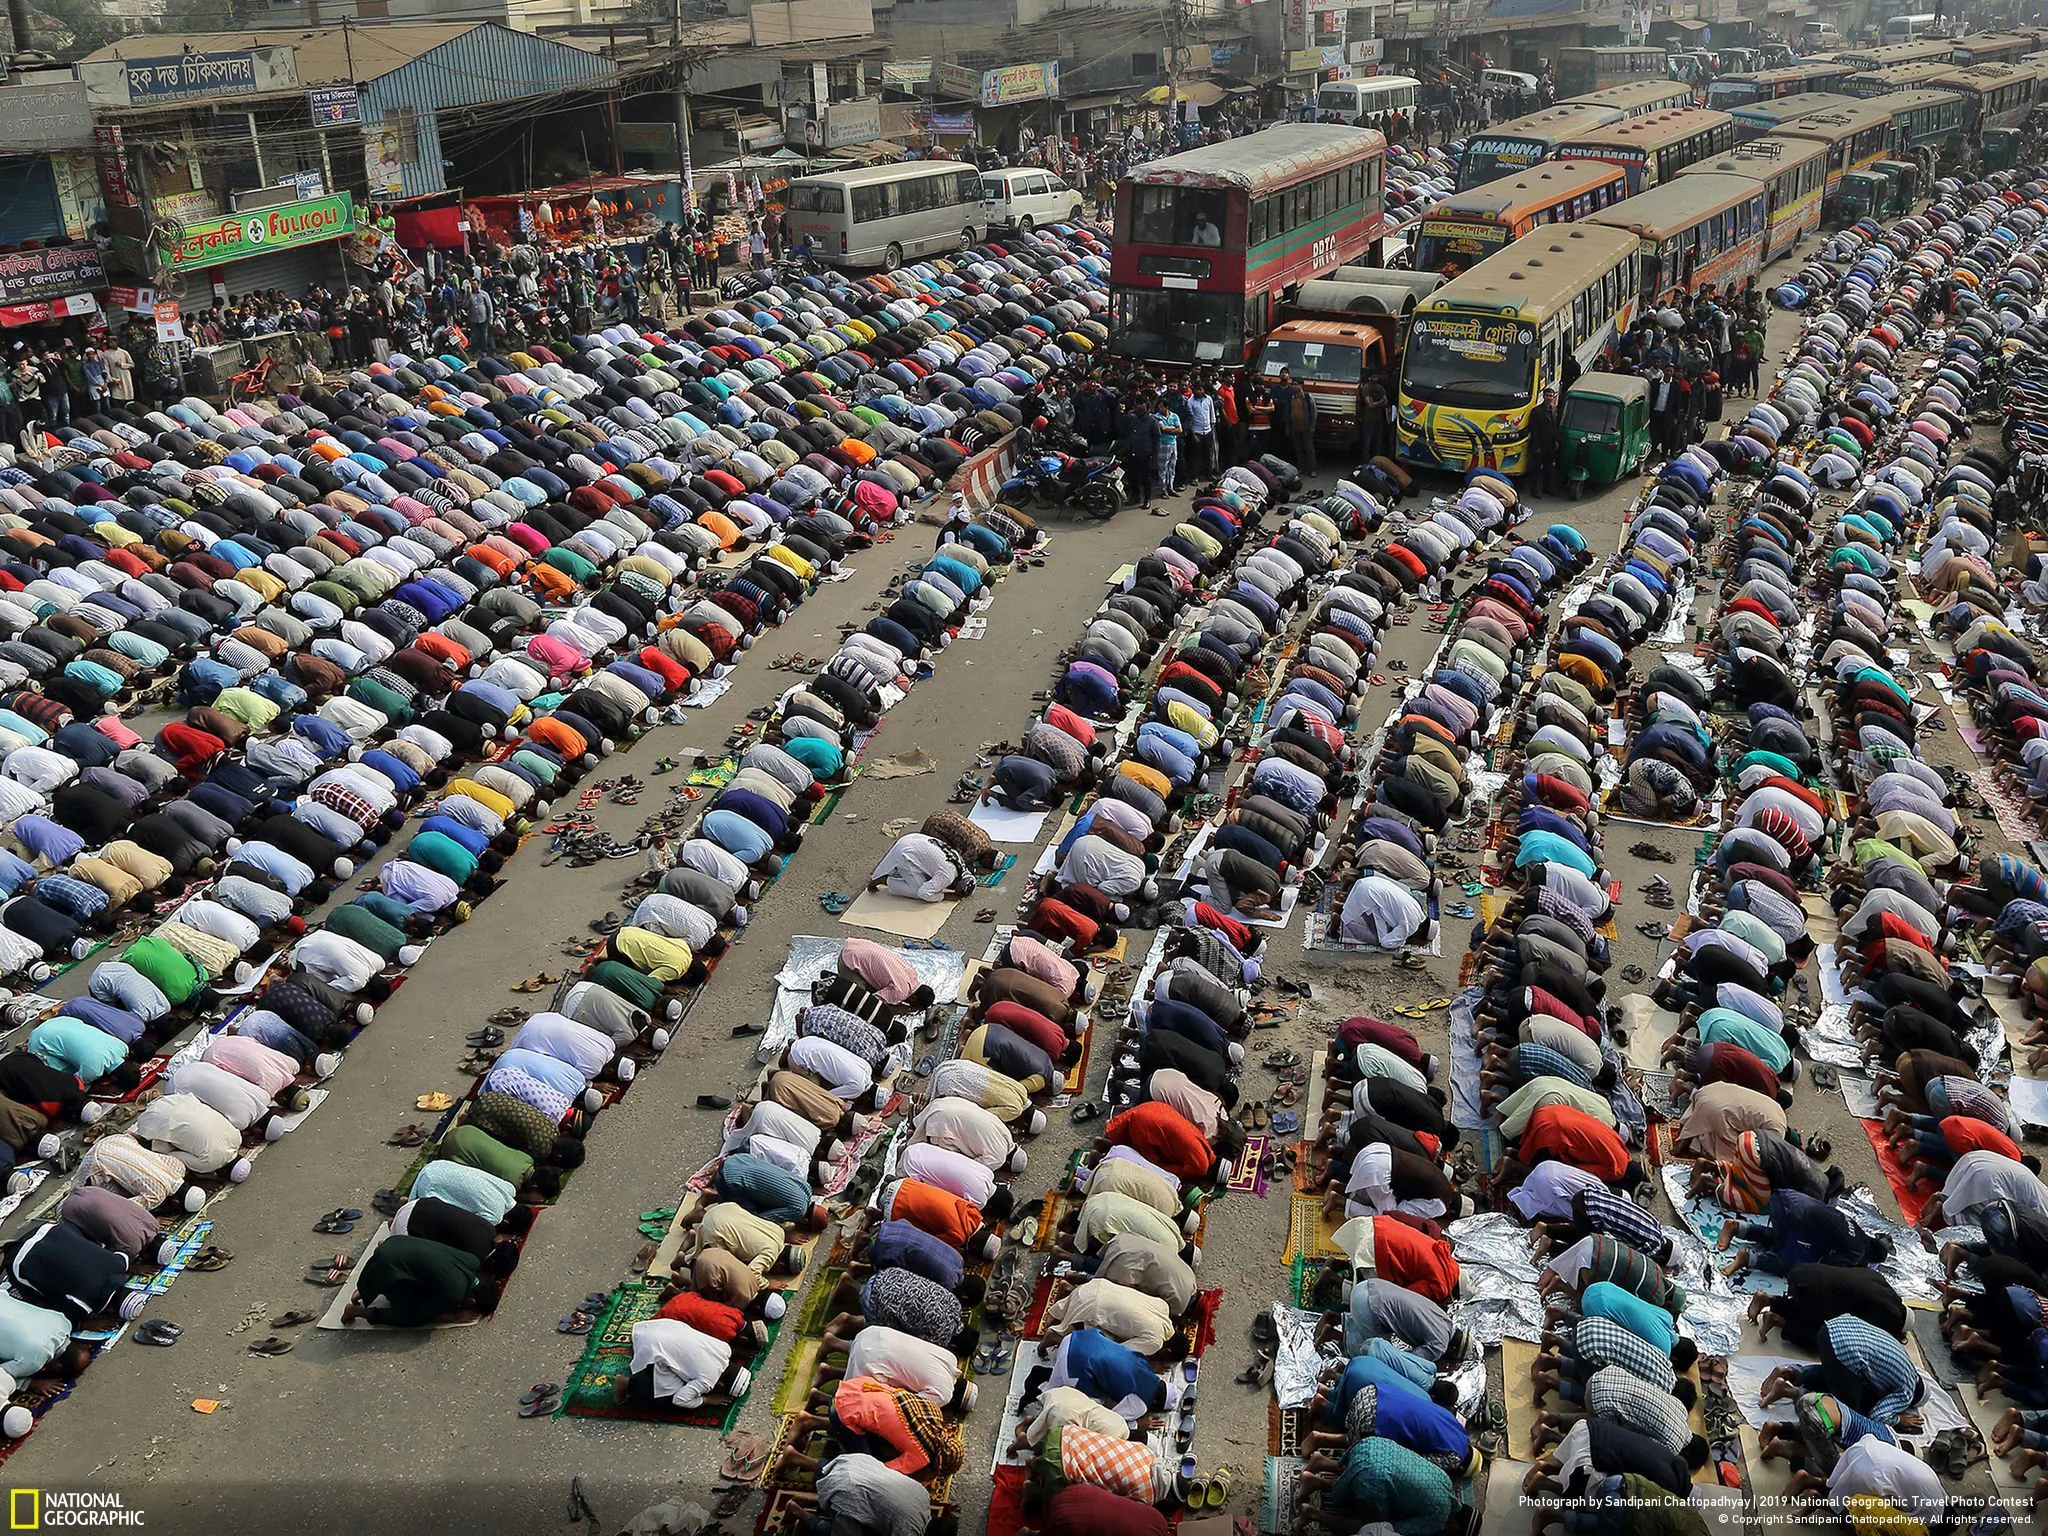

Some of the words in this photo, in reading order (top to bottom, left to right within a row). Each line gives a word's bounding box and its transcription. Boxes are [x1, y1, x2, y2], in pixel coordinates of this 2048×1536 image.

[1360, 42, 1375, 59] Apex
[128, 68, 152, 93] হক
[155, 65, 179, 88] দন্ত
[181, 55, 252, 85] চিকিৎসালয়
[1470, 140, 1543, 157] ANANNA
[269, 208, 337, 237] FULKOLI
[47, 247, 99, 270] টেলিকম
[1312, 234, 1337, 270] BRTC
[1428, 319, 1481, 340] আজমেরী
[1485, 322, 1518, 344] গ্লোরী
